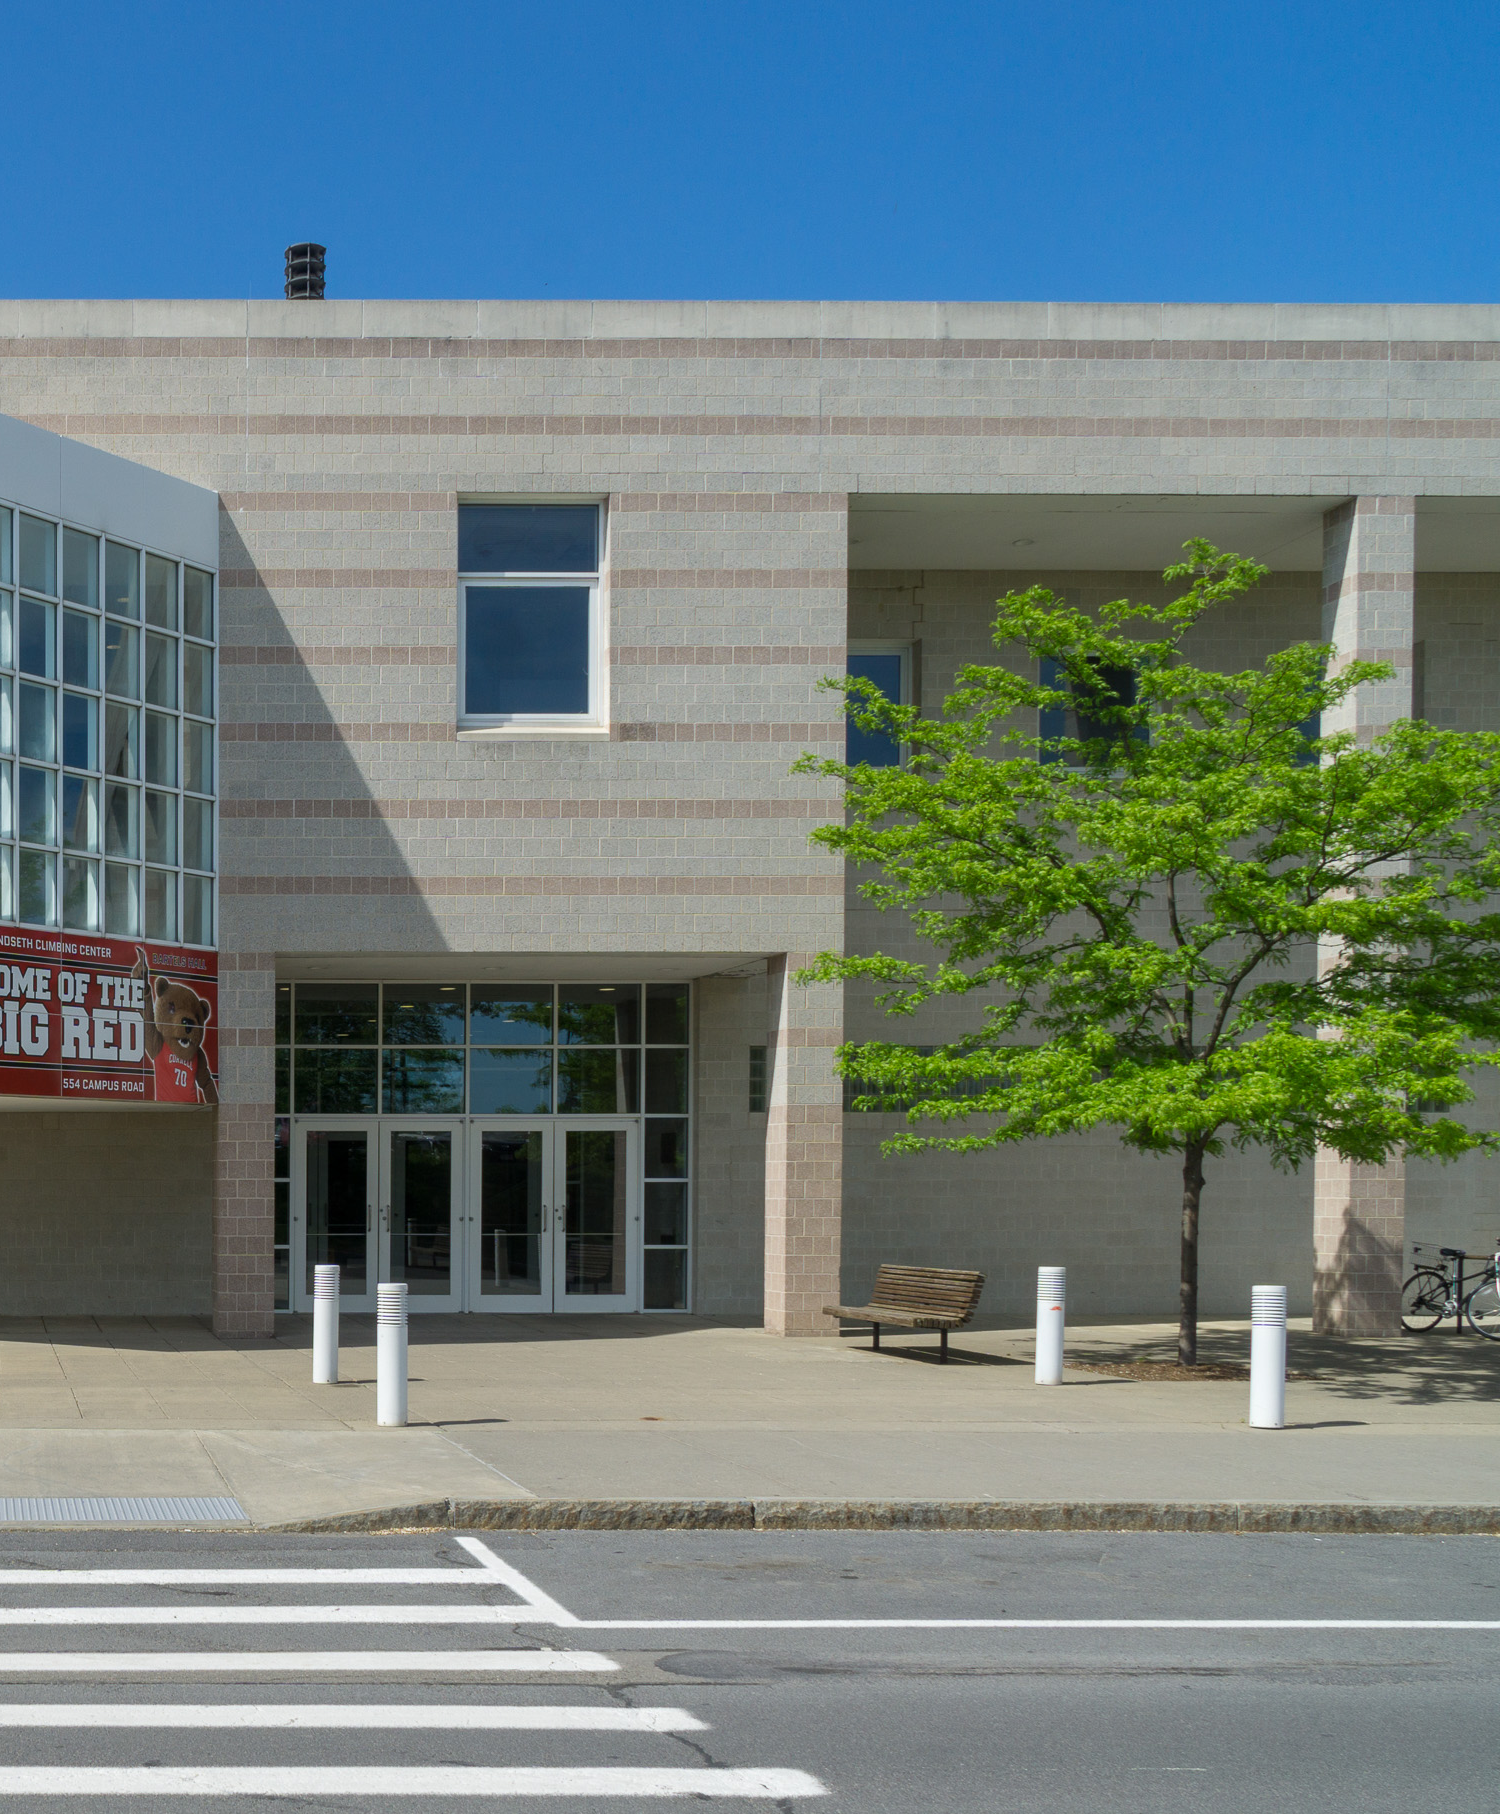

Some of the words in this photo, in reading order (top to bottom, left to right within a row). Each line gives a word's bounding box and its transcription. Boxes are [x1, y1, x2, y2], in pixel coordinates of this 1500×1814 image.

[35, 939, 78, 955] CLIMBING
[79, 944, 112, 959] CENTER
[152, 953, 187, 968] BARTELS
[188, 957, 207, 970] HALL
[57, 970, 91, 1004] OF
[96, 974, 145, 1009] THE
[61, 1005, 145, 1063] RED
[63, 1078, 81, 1090] 554
[82, 1079, 119, 1092] CAMPUS
[121, 1081, 145, 1093] ROAD
[174, 1068, 187, 1087] 70
